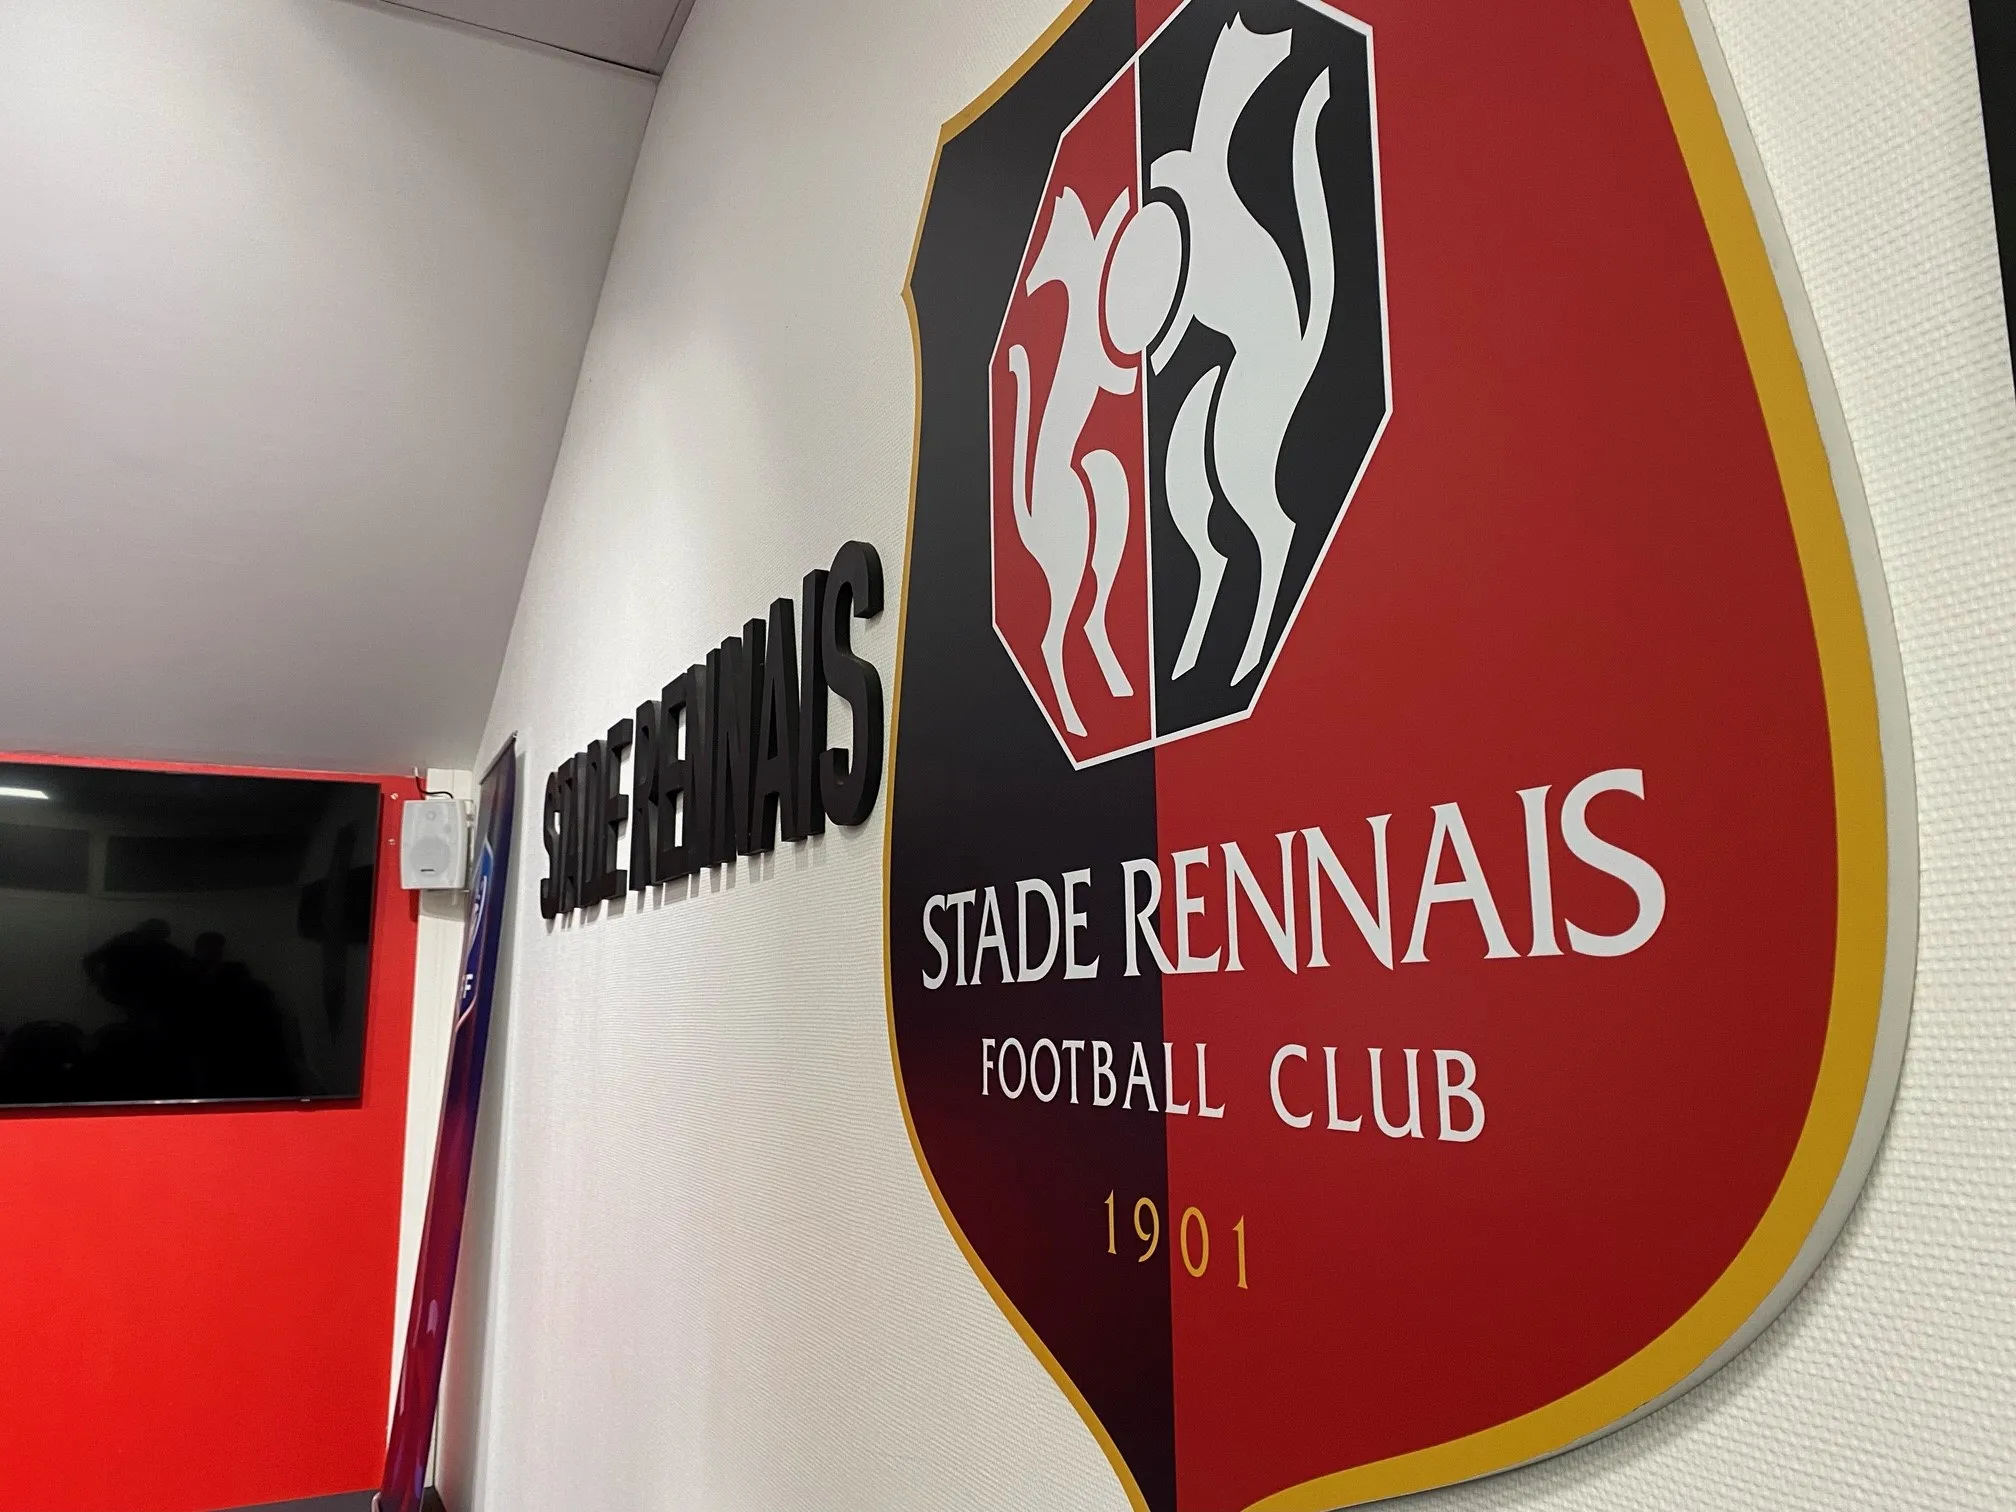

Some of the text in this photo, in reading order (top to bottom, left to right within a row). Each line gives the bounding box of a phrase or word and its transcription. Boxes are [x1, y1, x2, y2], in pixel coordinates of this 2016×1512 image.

[540, 540, 884, 920] STADE RENNAIS
[922, 768, 1666, 990] STADE RENNAIS
[981, 1037, 1486, 1143] FOOTBALL CLUB
[1105, 1189, 1249, 1290] 1901
